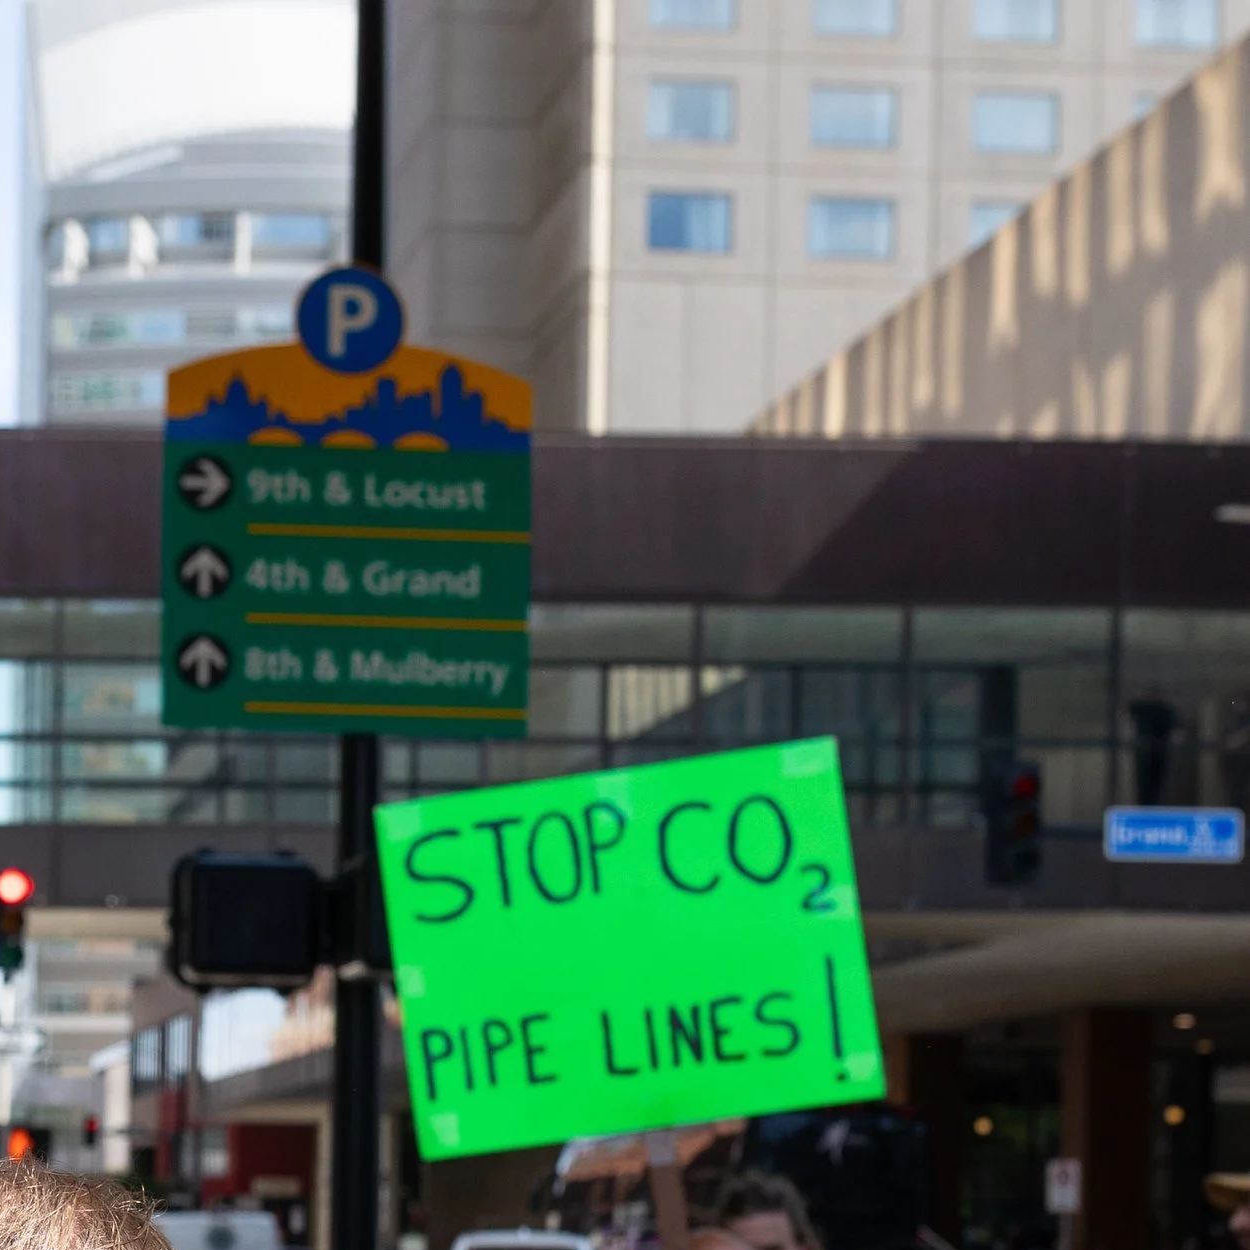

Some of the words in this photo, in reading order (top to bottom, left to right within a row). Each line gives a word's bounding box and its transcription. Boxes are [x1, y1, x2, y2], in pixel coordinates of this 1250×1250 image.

[326, 283, 379, 358] P
[246, 468, 310, 504] 9th
[322, 471, 352, 507] &
[364, 475, 487, 511] Locust
[245, 558, 309, 593] 4th
[322, 562, 350, 595] &
[362, 560, 481, 598] Grand
[244, 647, 302, 682] 8th
[313, 650, 339, 684] &
[350, 650, 511, 696] Mulberry
[404, 801, 628, 924] STOP
[420, 1013, 559, 1102] PIPE
